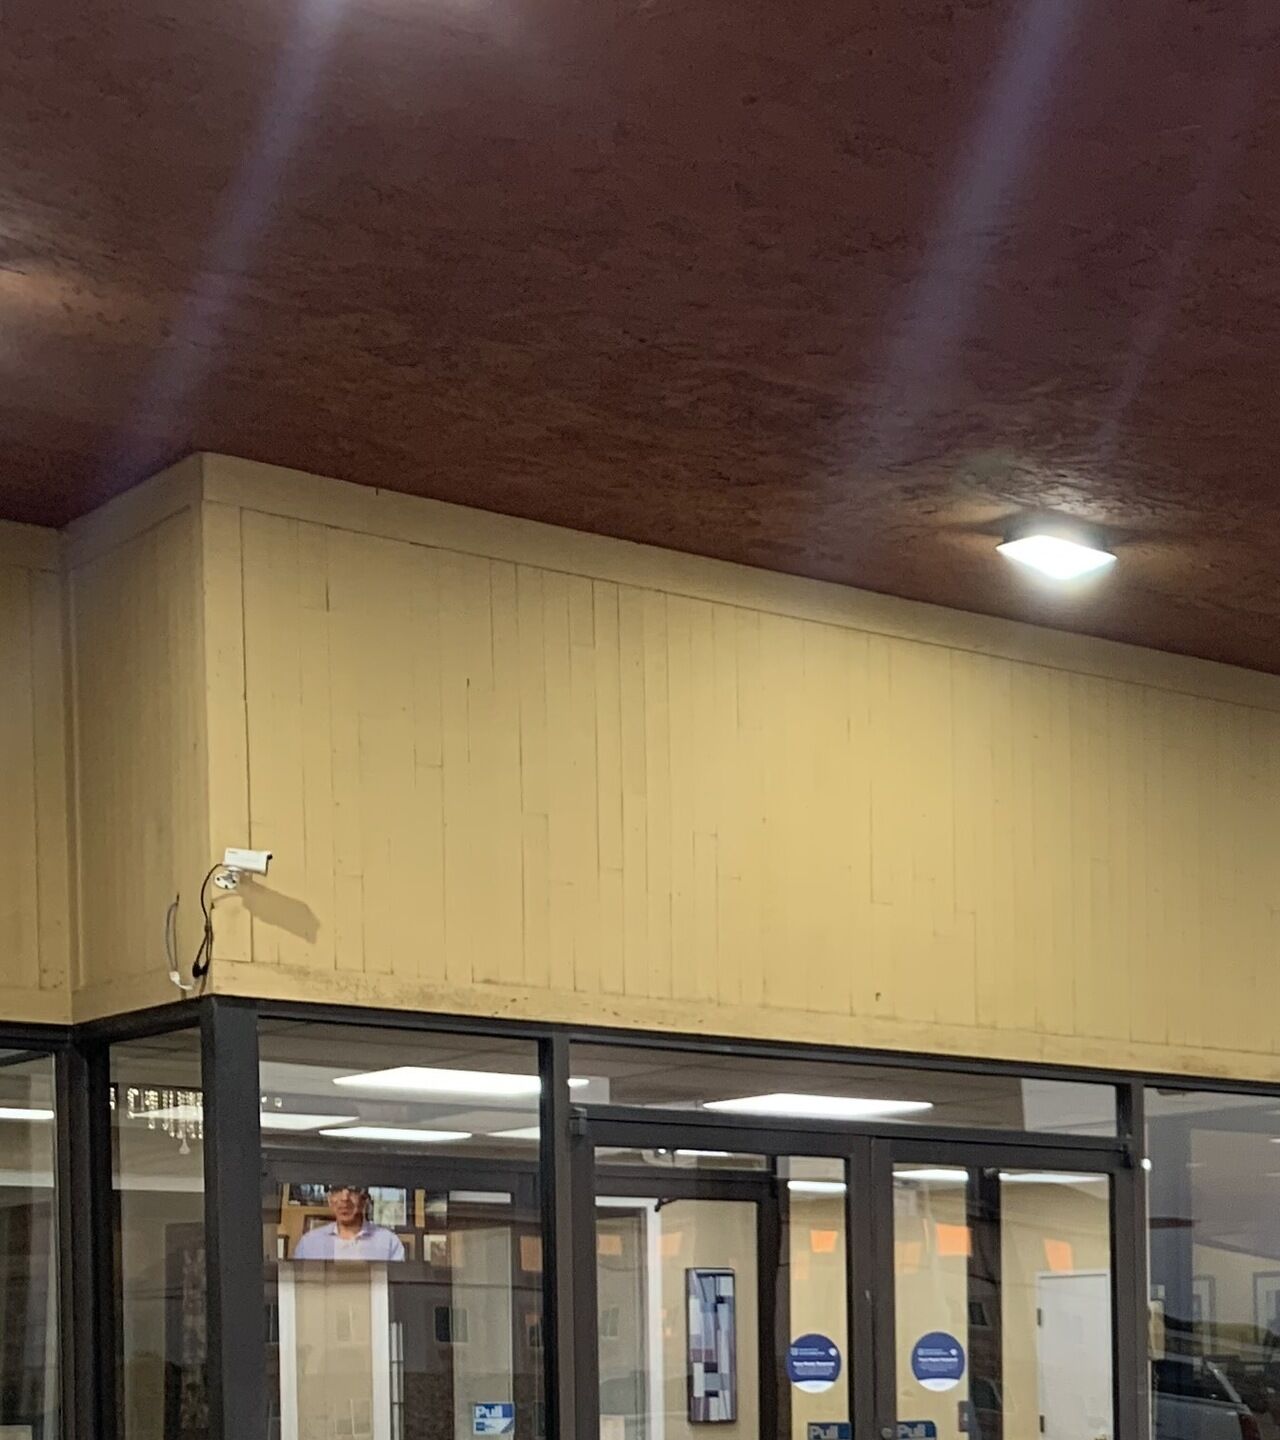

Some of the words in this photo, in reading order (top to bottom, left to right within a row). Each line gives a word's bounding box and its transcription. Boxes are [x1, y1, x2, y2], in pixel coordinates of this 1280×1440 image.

[475, 1405, 502, 1418] Pull
[810, 1425, 838, 1439] Pull
[897, 1424, 926, 1438] Pull
